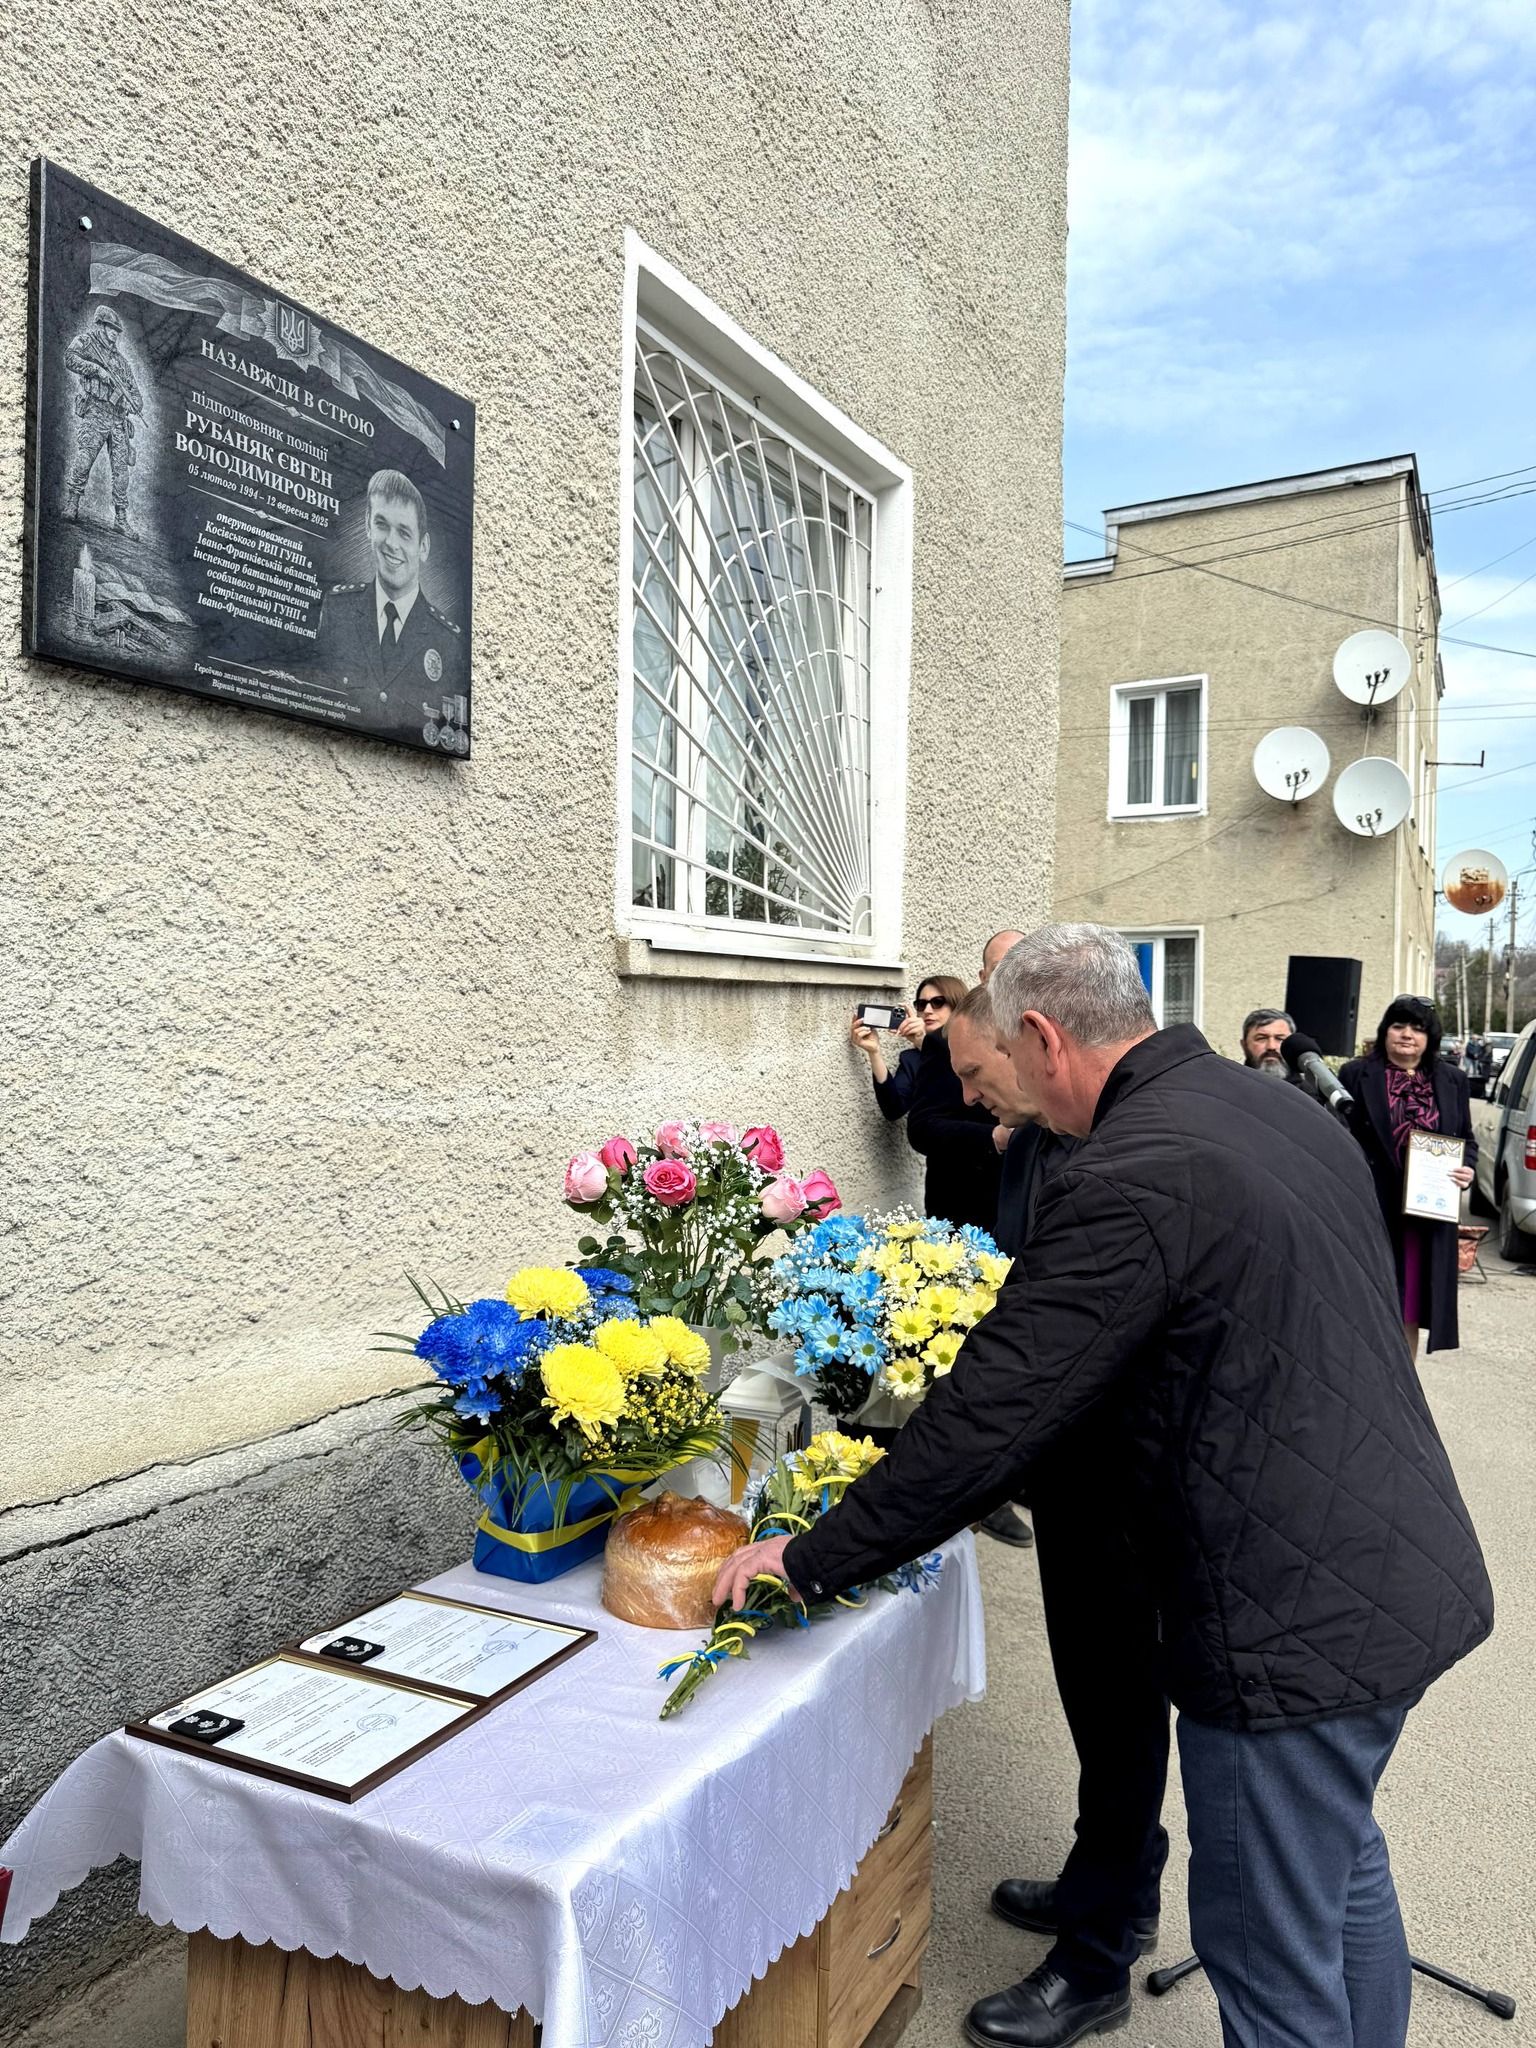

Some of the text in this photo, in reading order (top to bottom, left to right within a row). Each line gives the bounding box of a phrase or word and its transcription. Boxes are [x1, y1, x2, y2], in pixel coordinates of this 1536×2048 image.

[200, 338, 374, 437] НАЗАВЖДИ В СТРОЮ
[185, 409, 332, 489] РУБАНЯК ЄВГЕН
[191, 390, 328, 461] підполковник поліції
[175, 431, 339, 515] ВОЛОДИМИРОВИЧ
[188, 463, 198, 475] 05
[200, 471, 236, 491] лютого
[266, 494, 276, 506] 12
[276, 501, 308, 520] вересня
[310, 512, 328, 527] 2025
[204, 520, 256, 548] Косівського
[257, 539, 277, 556] РВП
[278, 547, 306, 566] ГУНП
[216, 512, 303, 551] оперуповноважений
[193, 546, 322, 599] інспектор батальйону поліції
[196, 532, 318, 586] Івано-Франківській області,
[206, 568, 309, 609] особливого призначення
[209, 581, 271, 612] (стрілецький)
[273, 601, 300, 620] ГУНП
[197, 592, 317, 639] Івано-Франківській області
